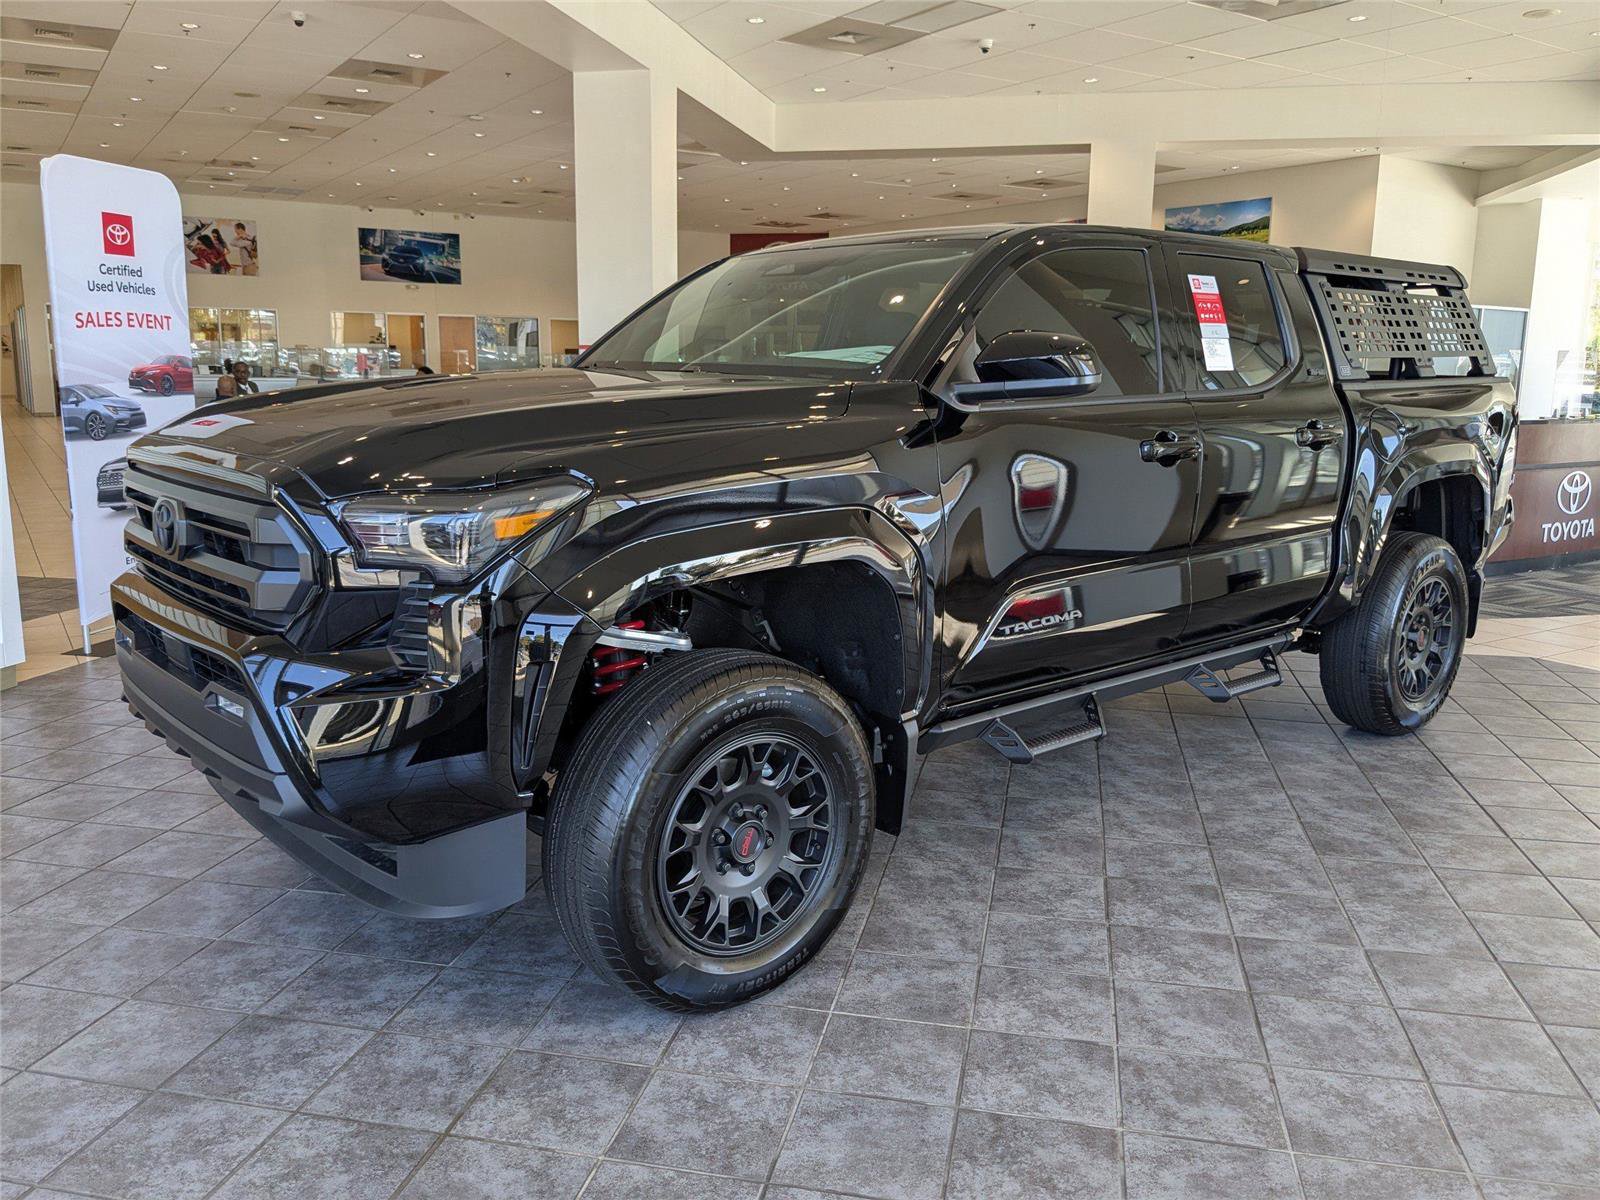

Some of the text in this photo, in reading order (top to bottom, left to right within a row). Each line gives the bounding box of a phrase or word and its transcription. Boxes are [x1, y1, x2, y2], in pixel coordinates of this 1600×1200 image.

[99, 263, 143, 278] Certified
[87, 280, 156, 296] Used Vehicles
[75, 311, 172, 331] SALES EVENT
[1541, 518, 1595, 543] TOYOTA
[998, 609, 1083, 635] TACOMA
